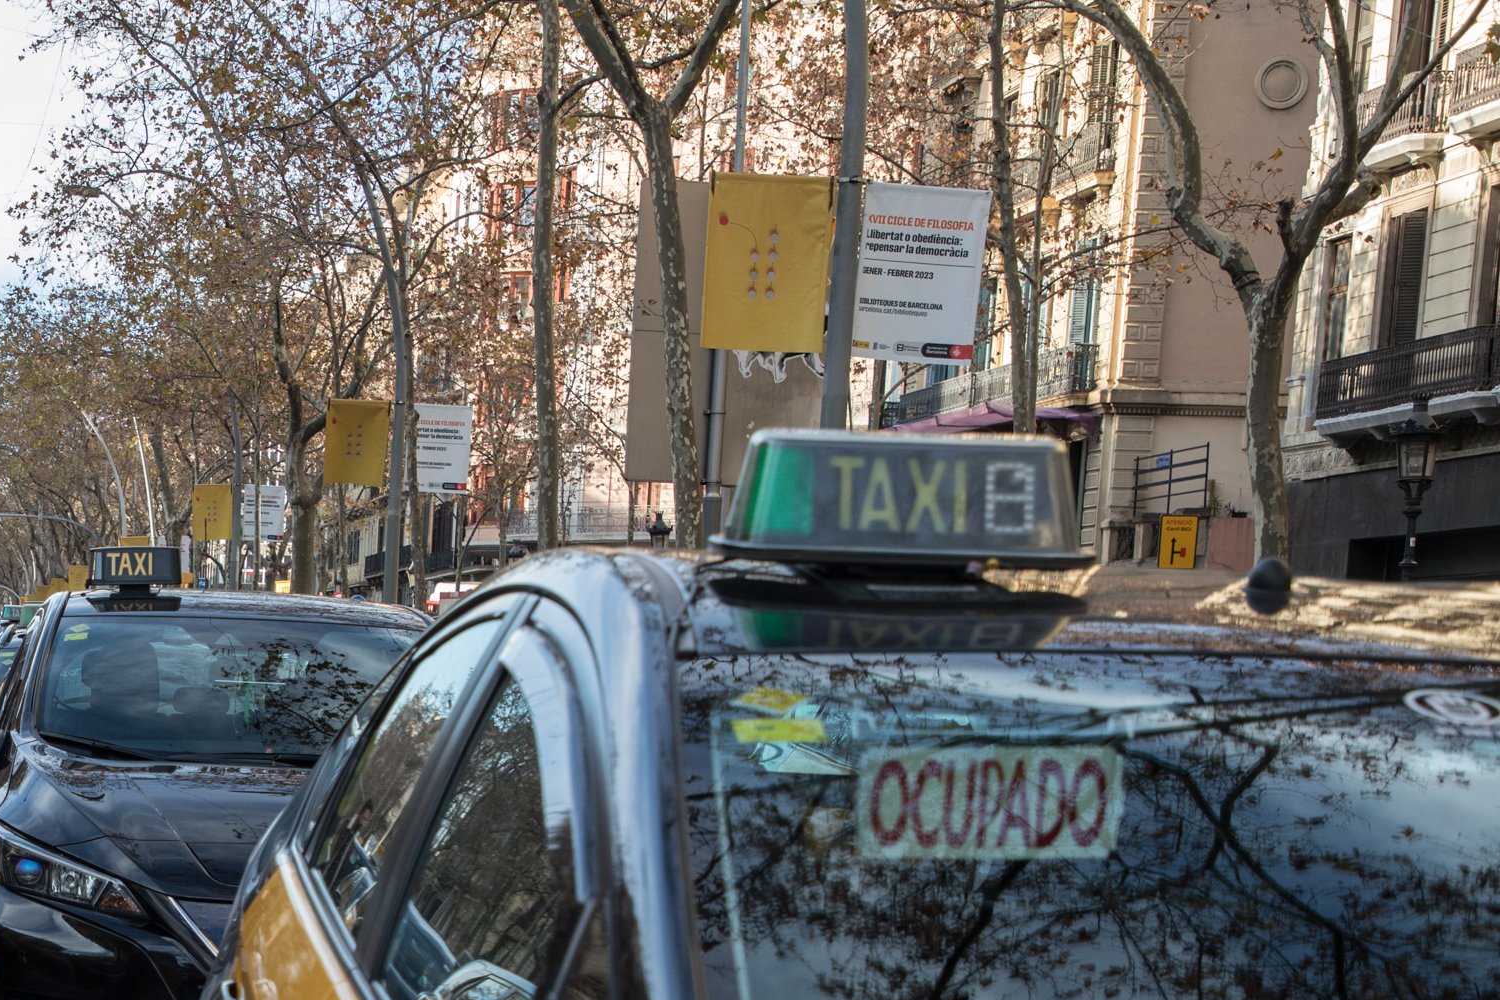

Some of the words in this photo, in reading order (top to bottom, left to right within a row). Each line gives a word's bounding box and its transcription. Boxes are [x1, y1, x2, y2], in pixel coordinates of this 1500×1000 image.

[887, 216, 913, 227] CICLE
[914, 218, 927, 228] DE
[927, 219, 975, 231] FILOSOFIA
[866, 229, 903, 241] Llibertat
[904, 233, 911, 242] o
[912, 231, 963, 246] obediència:
[865, 242, 905, 254] repensar
[905, 244, 914, 254] la
[915, 245, 969, 258] democràcia
[887, 268, 914, 279] FEBRER
[914, 270, 934, 280] 2023
[898, 300, 907, 308] DE
[907, 301, 943, 311] BARCELONA
[828, 455, 968, 535] TAXI
[106, 552, 153, 577] TAXI
[869, 758, 1108, 849] OCUPADO
